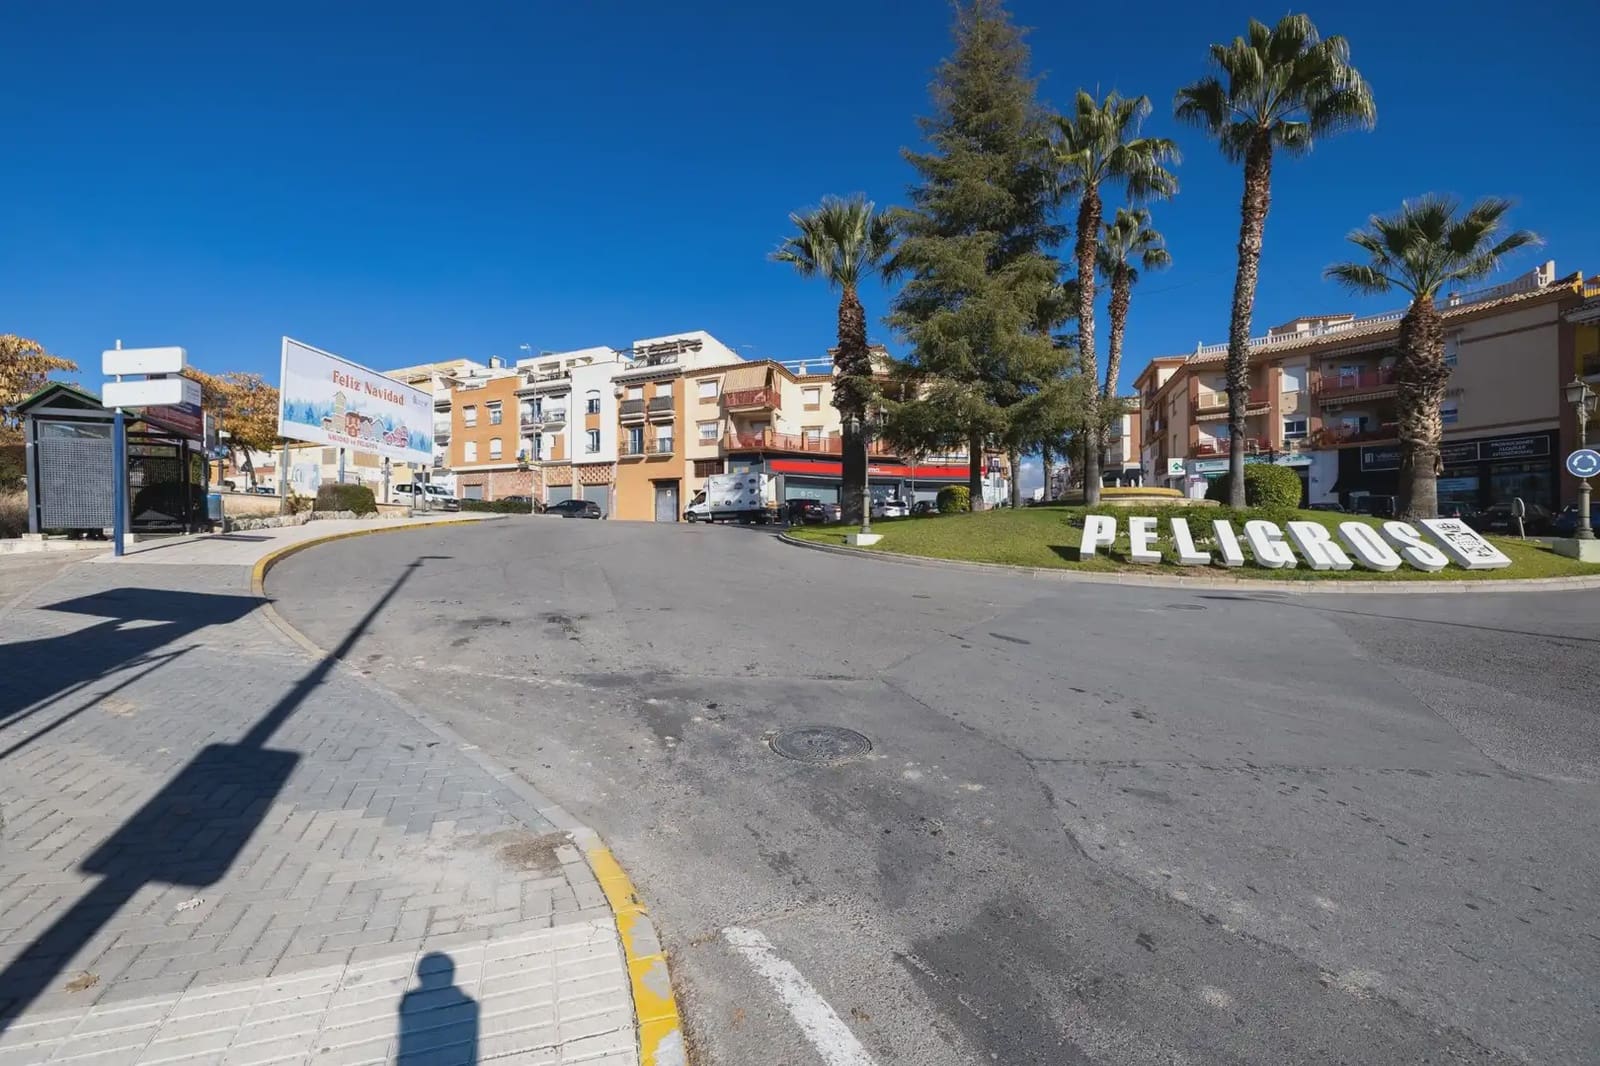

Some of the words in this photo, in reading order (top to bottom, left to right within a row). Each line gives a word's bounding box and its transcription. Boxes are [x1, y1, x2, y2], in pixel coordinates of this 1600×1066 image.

[332, 370, 361, 392] Feliz
[364, 381, 405, 406] Navidad
[1079, 514, 1450, 572] PELIGROS
